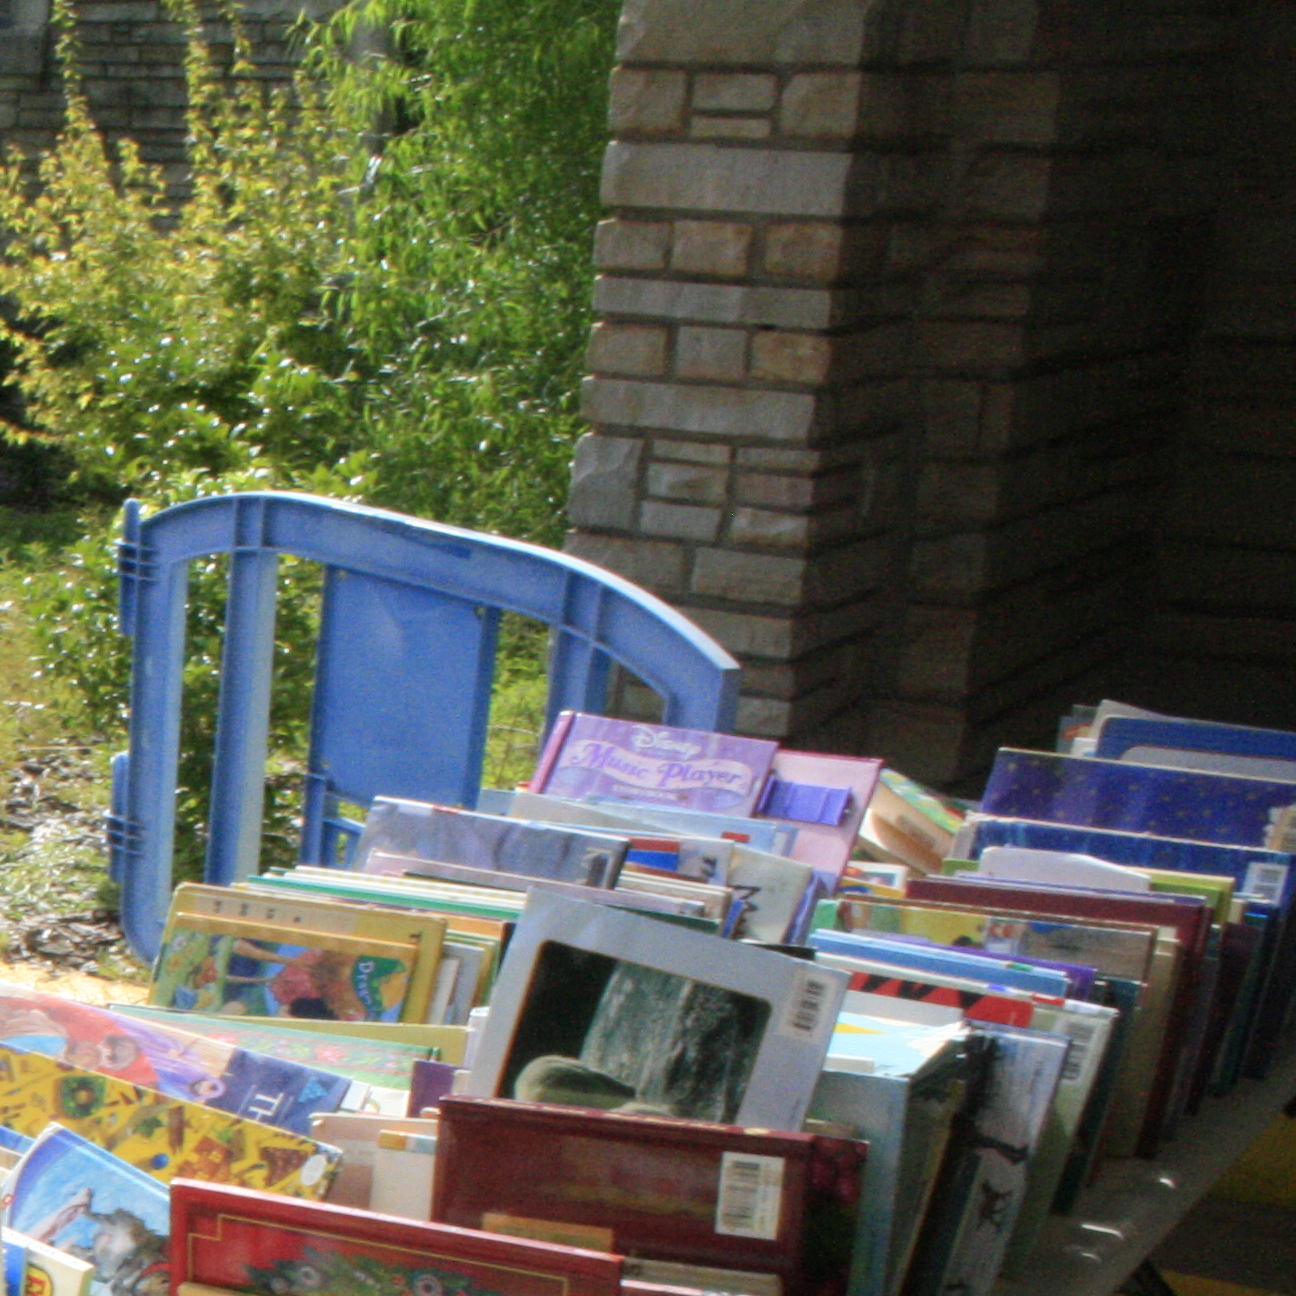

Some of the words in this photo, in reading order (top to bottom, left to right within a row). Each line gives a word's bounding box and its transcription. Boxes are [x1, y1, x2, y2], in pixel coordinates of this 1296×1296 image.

[631, 724, 702, 759] Disney
[572, 742, 650, 780] Music
[657, 758, 746, 788] Player
